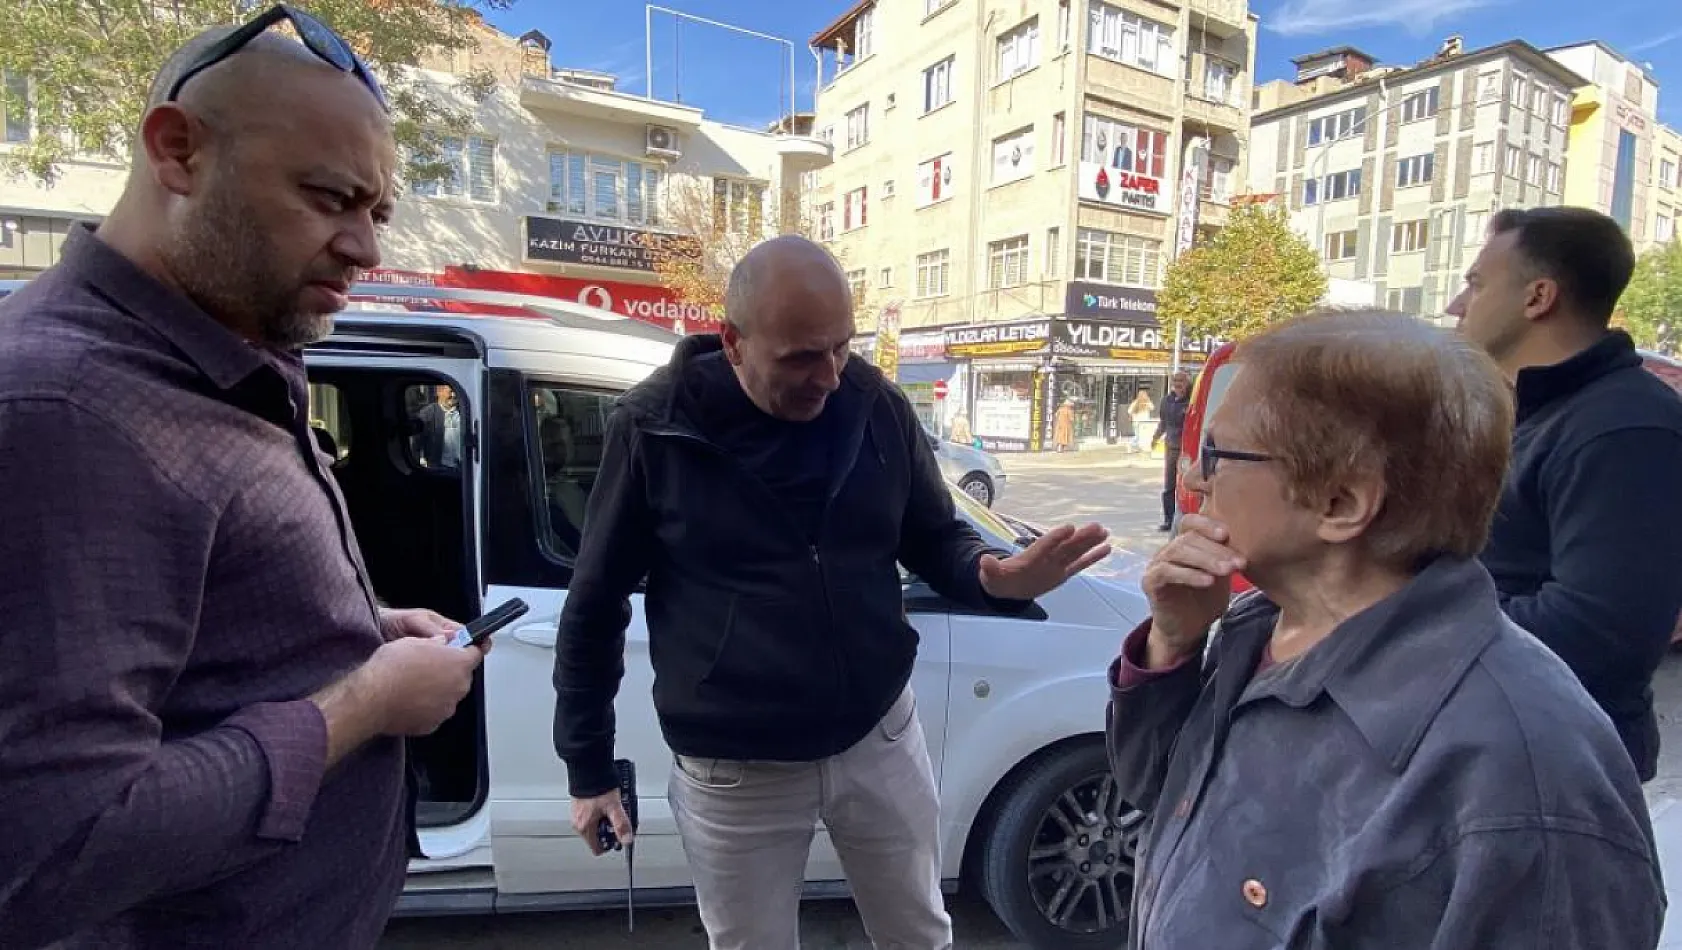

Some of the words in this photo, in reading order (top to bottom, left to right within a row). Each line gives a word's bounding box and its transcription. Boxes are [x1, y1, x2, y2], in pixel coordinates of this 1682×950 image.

[1120, 171, 1159, 194] ZAFER
[581, 243, 637, 259] FURKAN
[1098, 295, 1117, 309] Türk
[1120, 297, 1156, 312] Telekom
